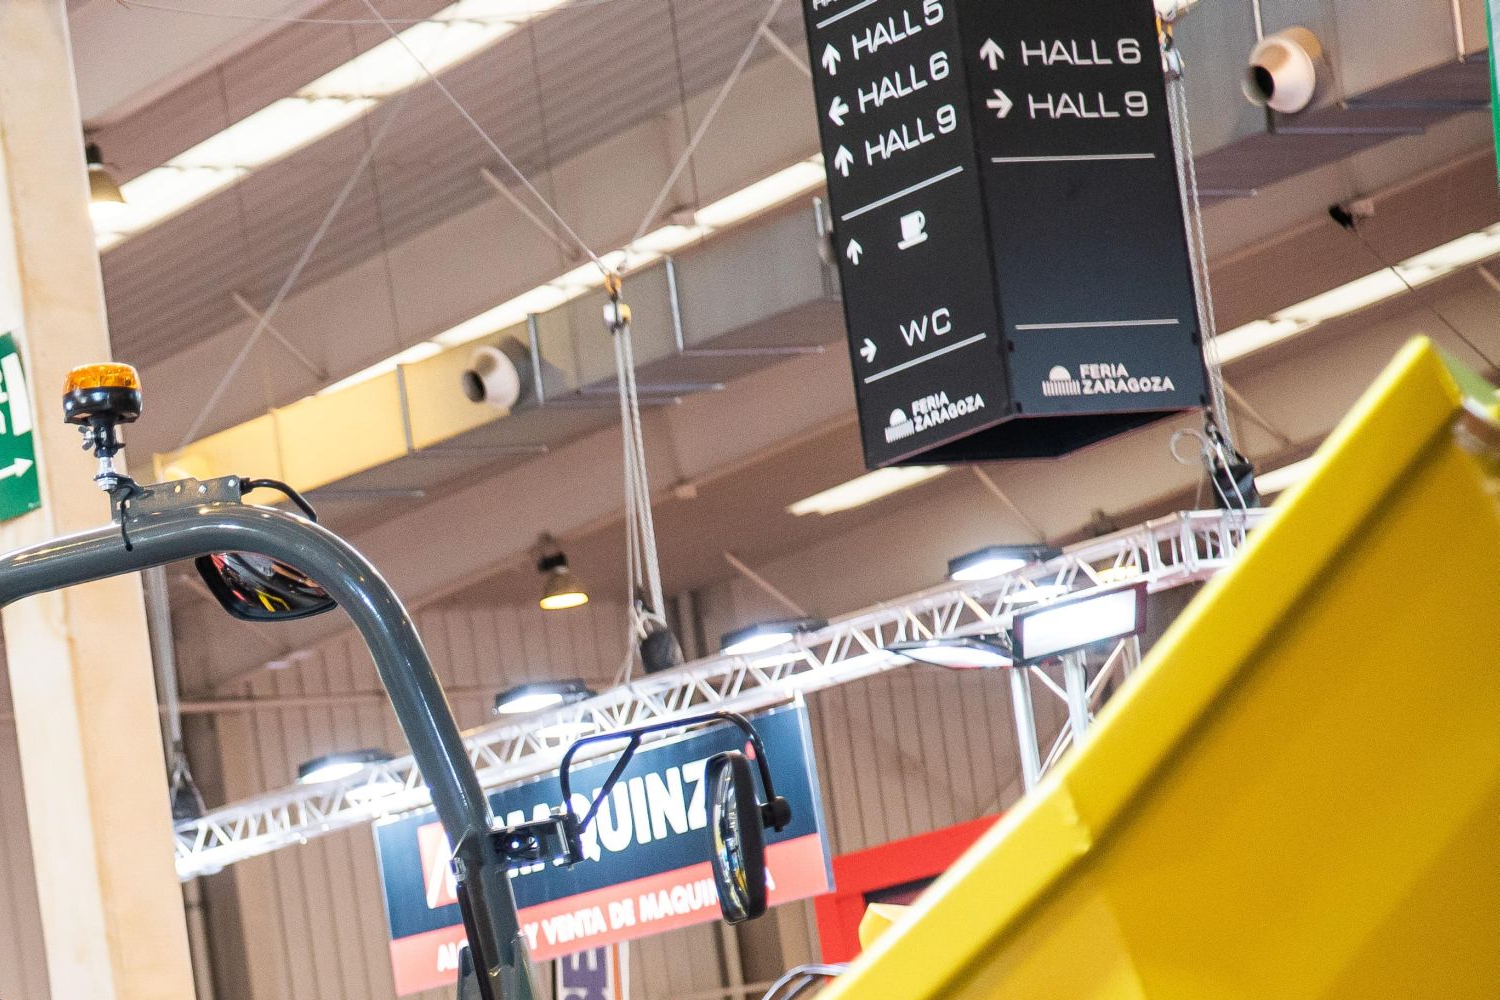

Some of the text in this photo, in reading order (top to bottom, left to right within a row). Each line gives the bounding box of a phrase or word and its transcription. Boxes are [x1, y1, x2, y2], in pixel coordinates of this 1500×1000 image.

[852, 0, 944, 60] HALL 5
[1021, 38, 1141, 65] HALL 6
[857, 51, 950, 113] HALL 6
[1029, 91, 1148, 118] HALL 9
[865, 104, 957, 165] HALL 9
[900, 308, 952, 346] WC
[1080, 363, 1129, 380] FERIA
[1082, 376, 1175, 395] ZARAGOZA
[911, 390, 950, 417] FERIA
[913, 393, 985, 433] ZARAGOZA
[541, 906, 607, 945] VENTA
[608, 898, 636, 930] DE
